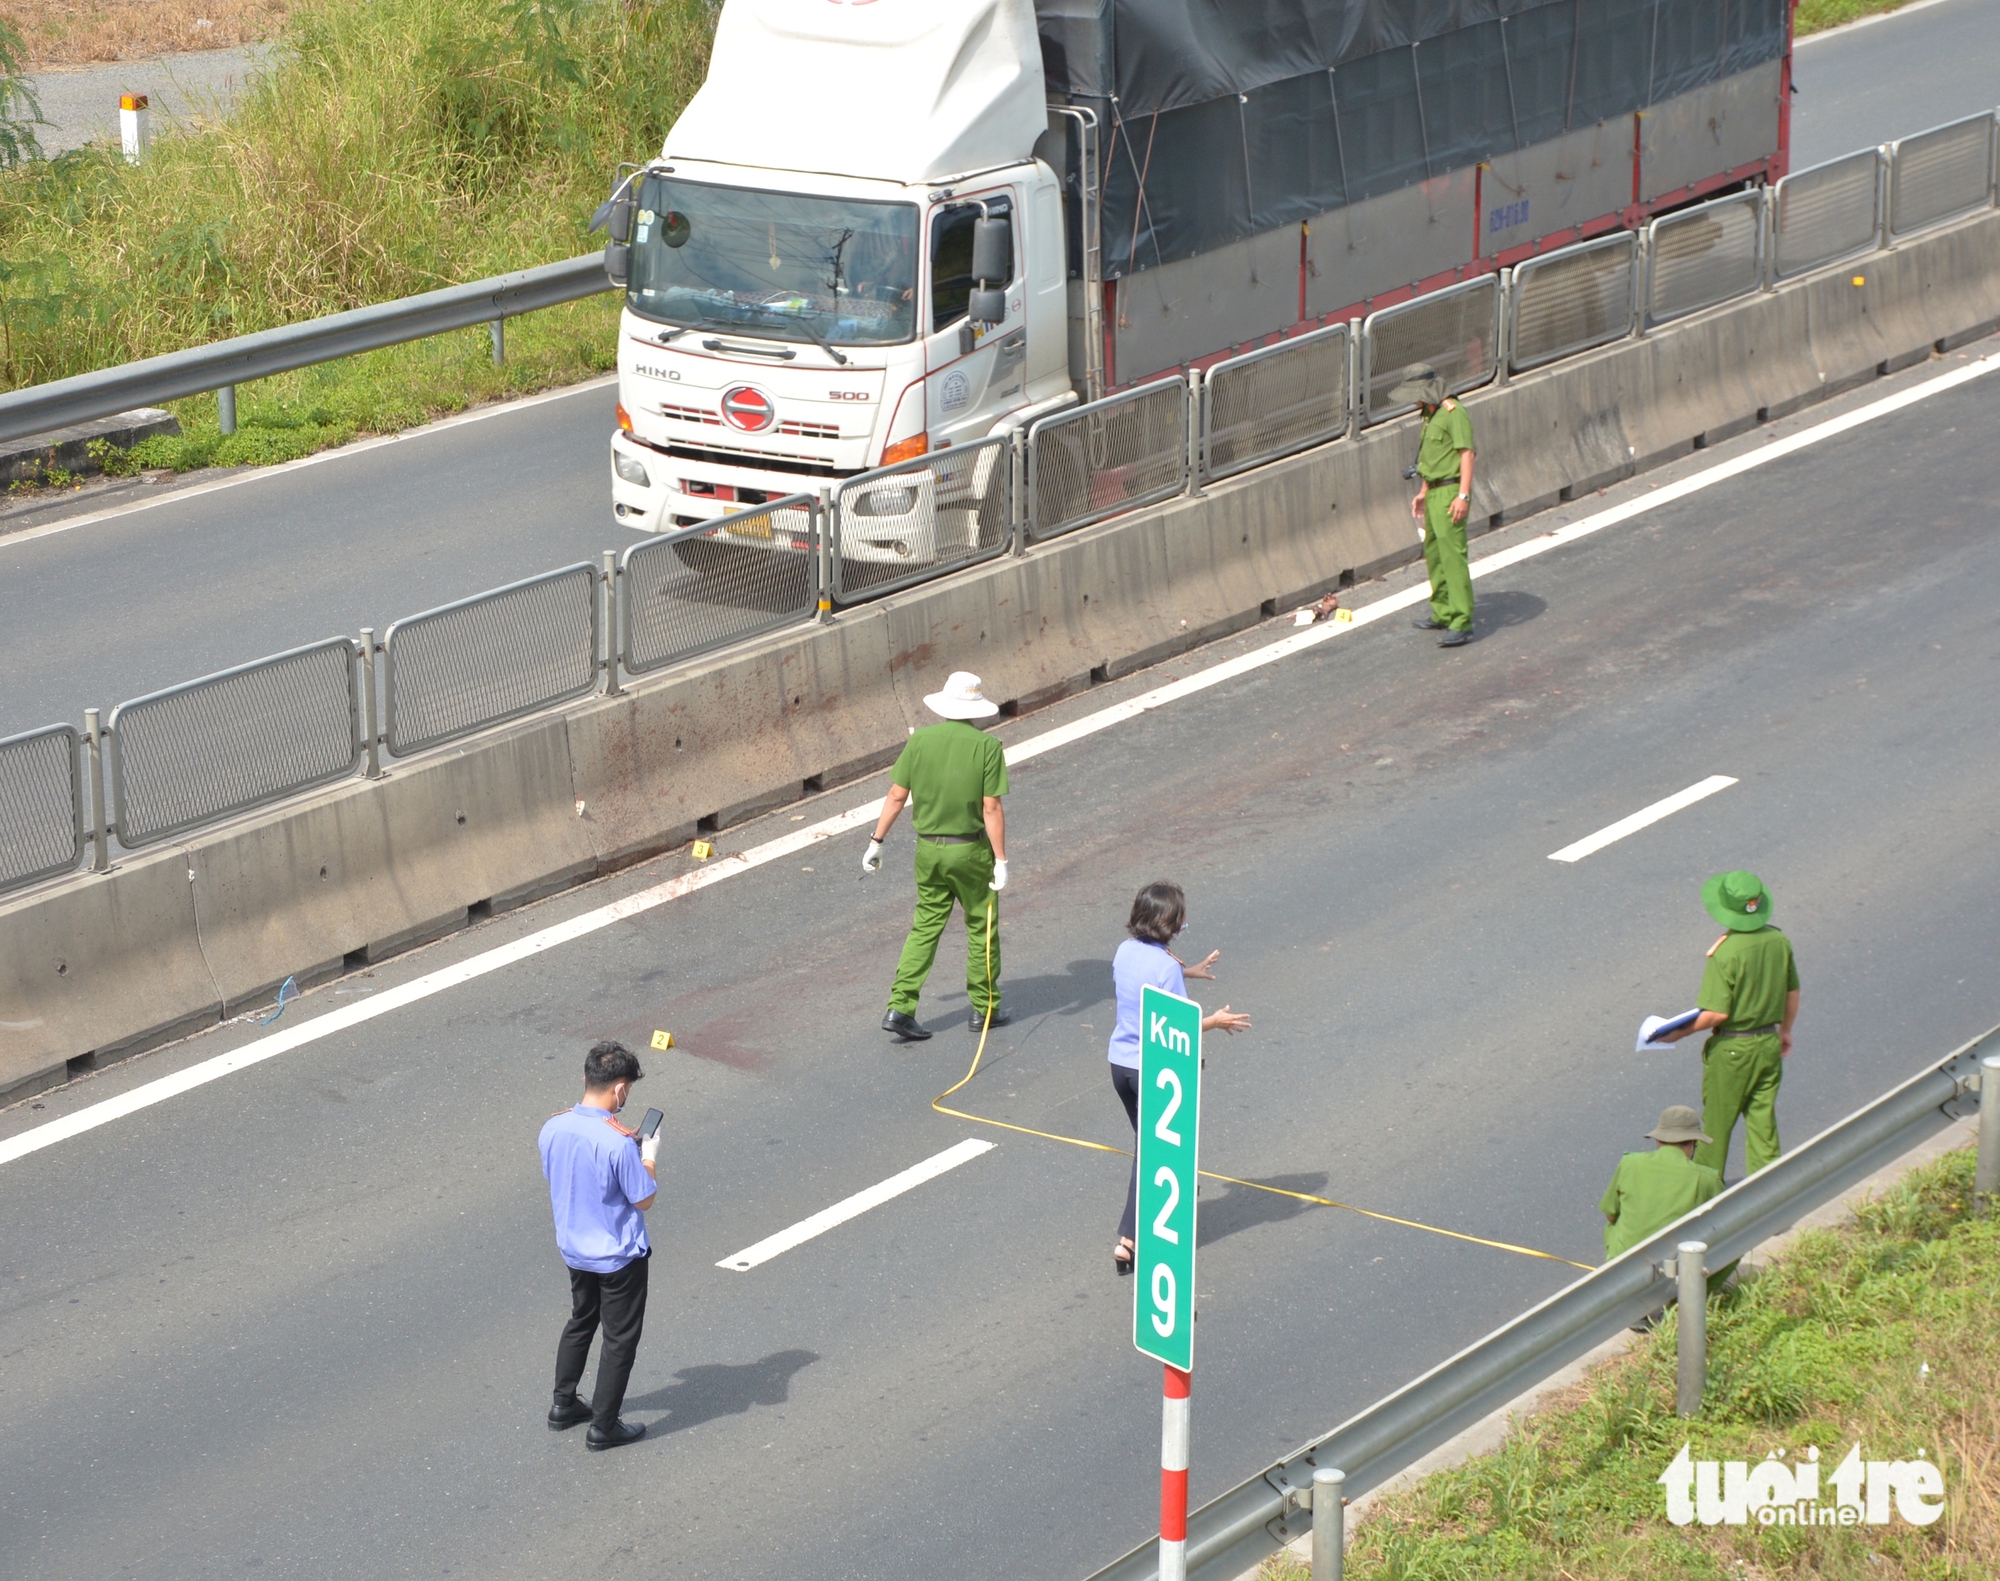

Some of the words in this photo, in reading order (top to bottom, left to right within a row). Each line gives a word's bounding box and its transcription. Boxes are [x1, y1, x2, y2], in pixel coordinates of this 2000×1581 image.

[636, 364, 681, 381] HINO
[829, 391, 870, 401] 500
[697, 845, 704, 855] 3
[1151, 1011, 1190, 1056] Km
[656, 1034, 664, 1045] 2
